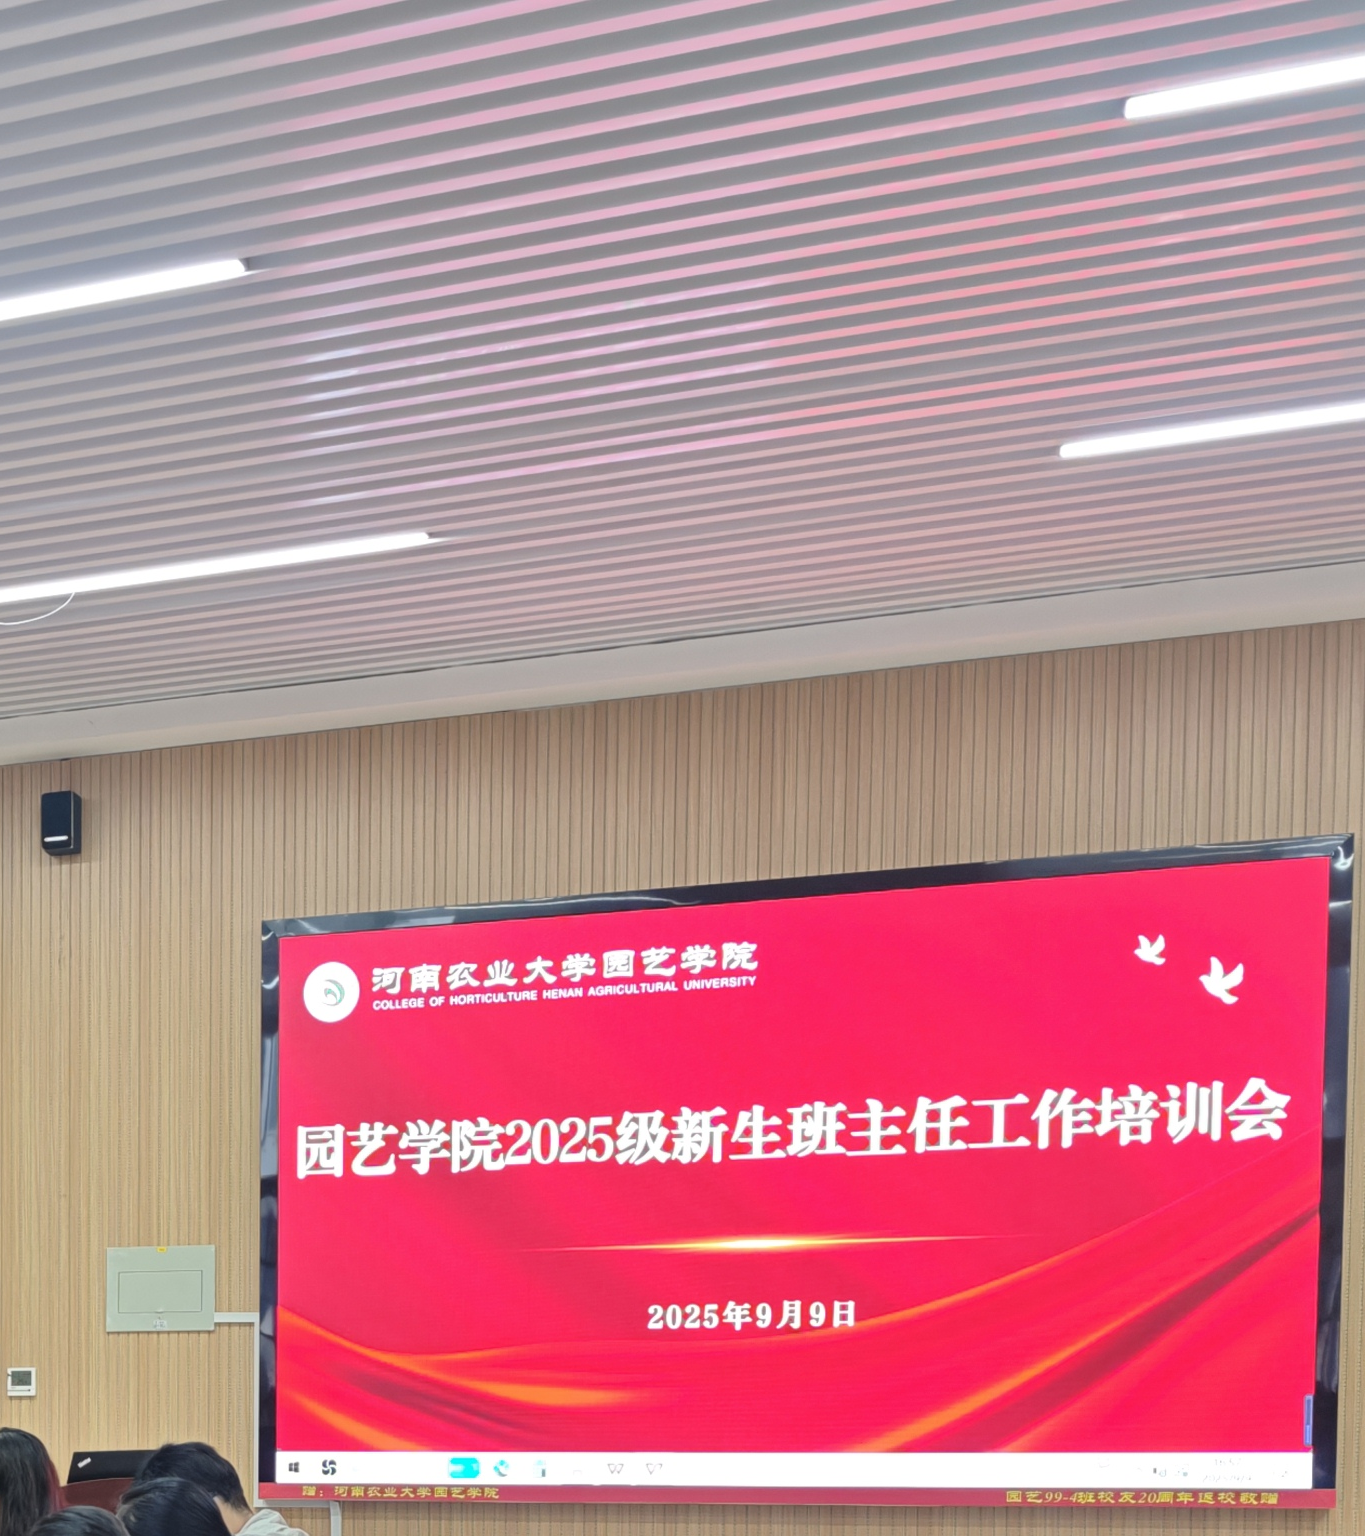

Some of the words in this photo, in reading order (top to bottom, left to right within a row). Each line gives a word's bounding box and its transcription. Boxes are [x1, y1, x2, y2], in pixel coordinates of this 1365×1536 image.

[372, 942, 758, 994] 河南农业大学园艺学院
[372, 997, 425, 1011] COLLEGE
[429, 996, 445, 1007] OF
[449, 990, 538, 1006] HORTICULTURE
[542, 987, 583, 999] HENAN
[587, 982, 678, 997] AGRICULTURAL
[683, 975, 757, 990] UNIVERSITY
[296, 1077, 1291, 1180] 园艺学院2025级新生班主任工作培训会
[647, 1299, 856, 1331] 2025年9月9日
